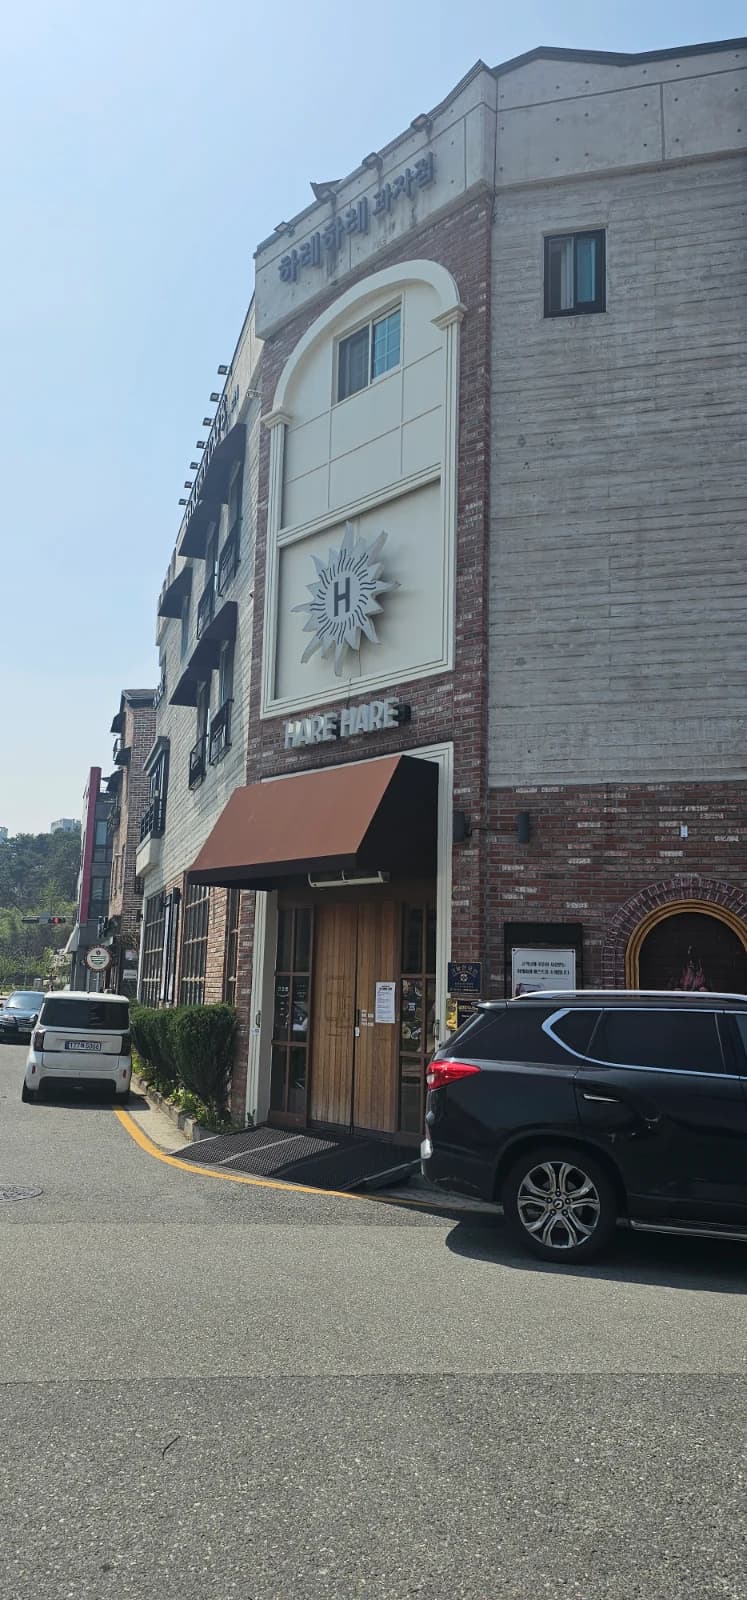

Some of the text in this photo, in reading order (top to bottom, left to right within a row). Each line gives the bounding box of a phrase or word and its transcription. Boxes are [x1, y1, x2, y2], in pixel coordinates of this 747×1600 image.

[278, 151, 435, 282] 하레하레 과자점
[333, 576, 351, 617] H
[284, 696, 400, 749] HARE HARE
